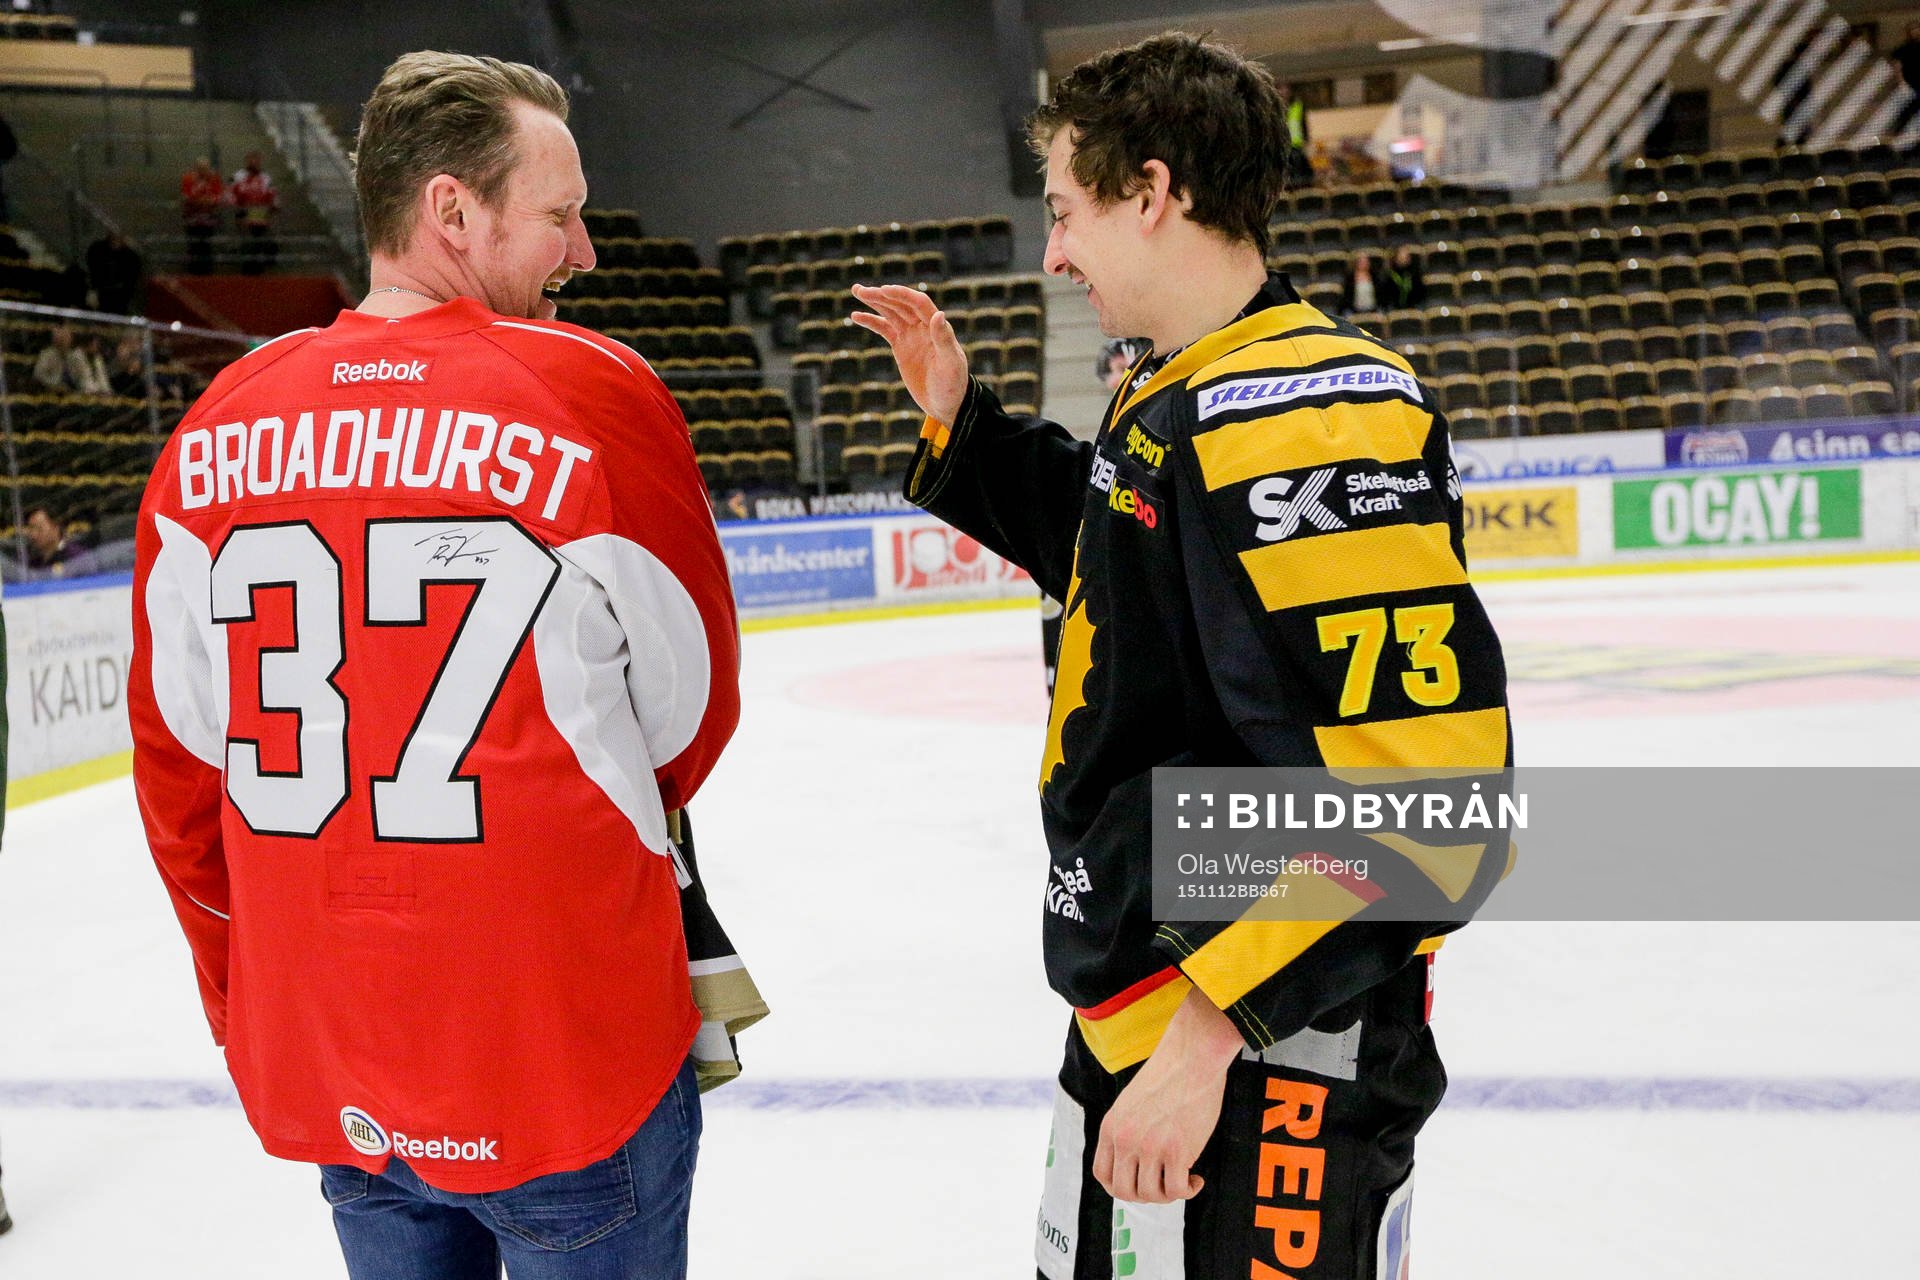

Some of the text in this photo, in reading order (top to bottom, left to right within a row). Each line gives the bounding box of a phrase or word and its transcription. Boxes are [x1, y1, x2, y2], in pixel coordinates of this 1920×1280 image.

[332, 359, 427, 385] Reebok
[1204, 371, 1413, 410] SKELLEFTEBUSS
[179, 407, 593, 522] BROADHURST
[1348, 492, 1403, 517] Kraft
[1651, 474, 1821, 547] OCAY!
[211, 515, 563, 844] 37
[1315, 603, 1461, 718] 73
[350, 1120, 376, 1144] AHL
[392, 1131, 499, 1161] Reebok
[1250, 1077, 1330, 1280] REP
